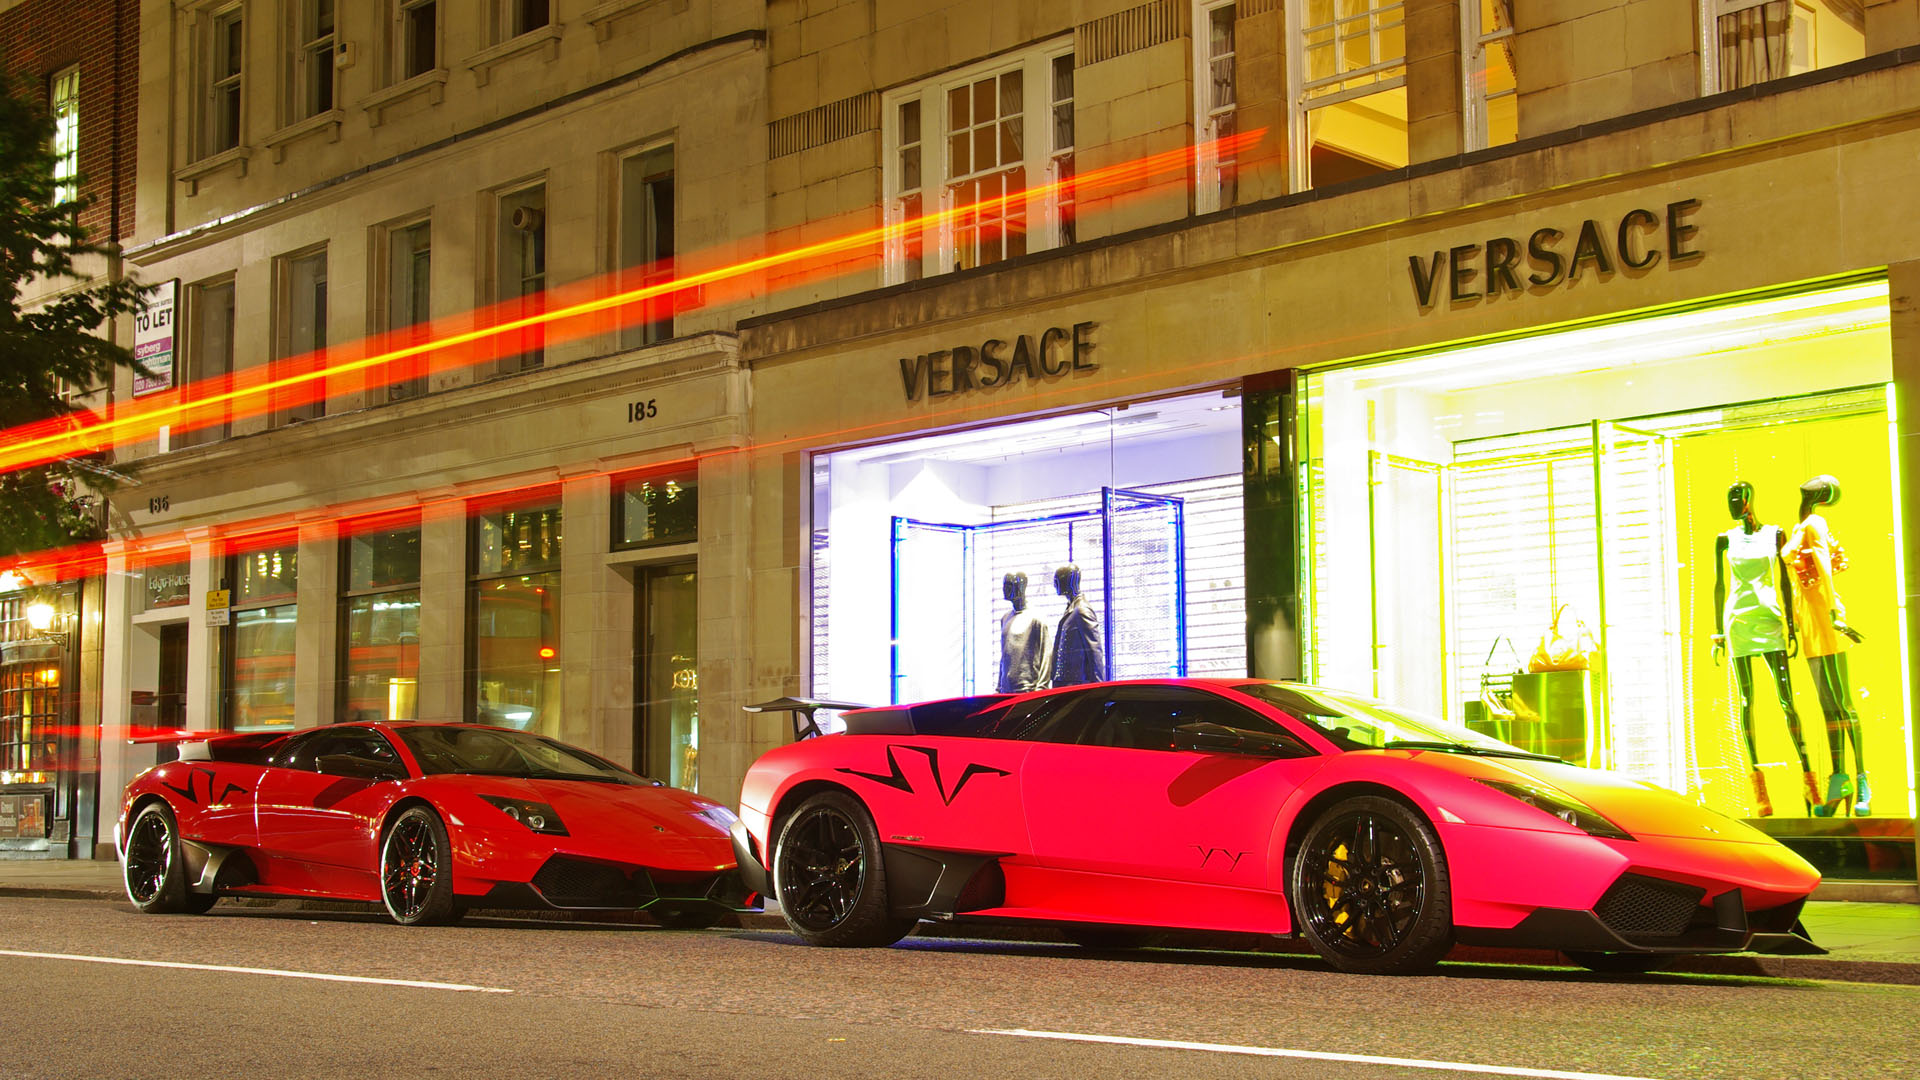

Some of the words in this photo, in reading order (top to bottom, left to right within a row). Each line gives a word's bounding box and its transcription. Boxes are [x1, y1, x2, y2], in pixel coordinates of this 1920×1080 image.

[1409, 198, 1702, 309] VERSACE
[137, 313, 150, 333] TO
[153, 307, 172, 328] LET
[900, 321, 1099, 402] VERSACE
[628, 398, 657, 423] 185
